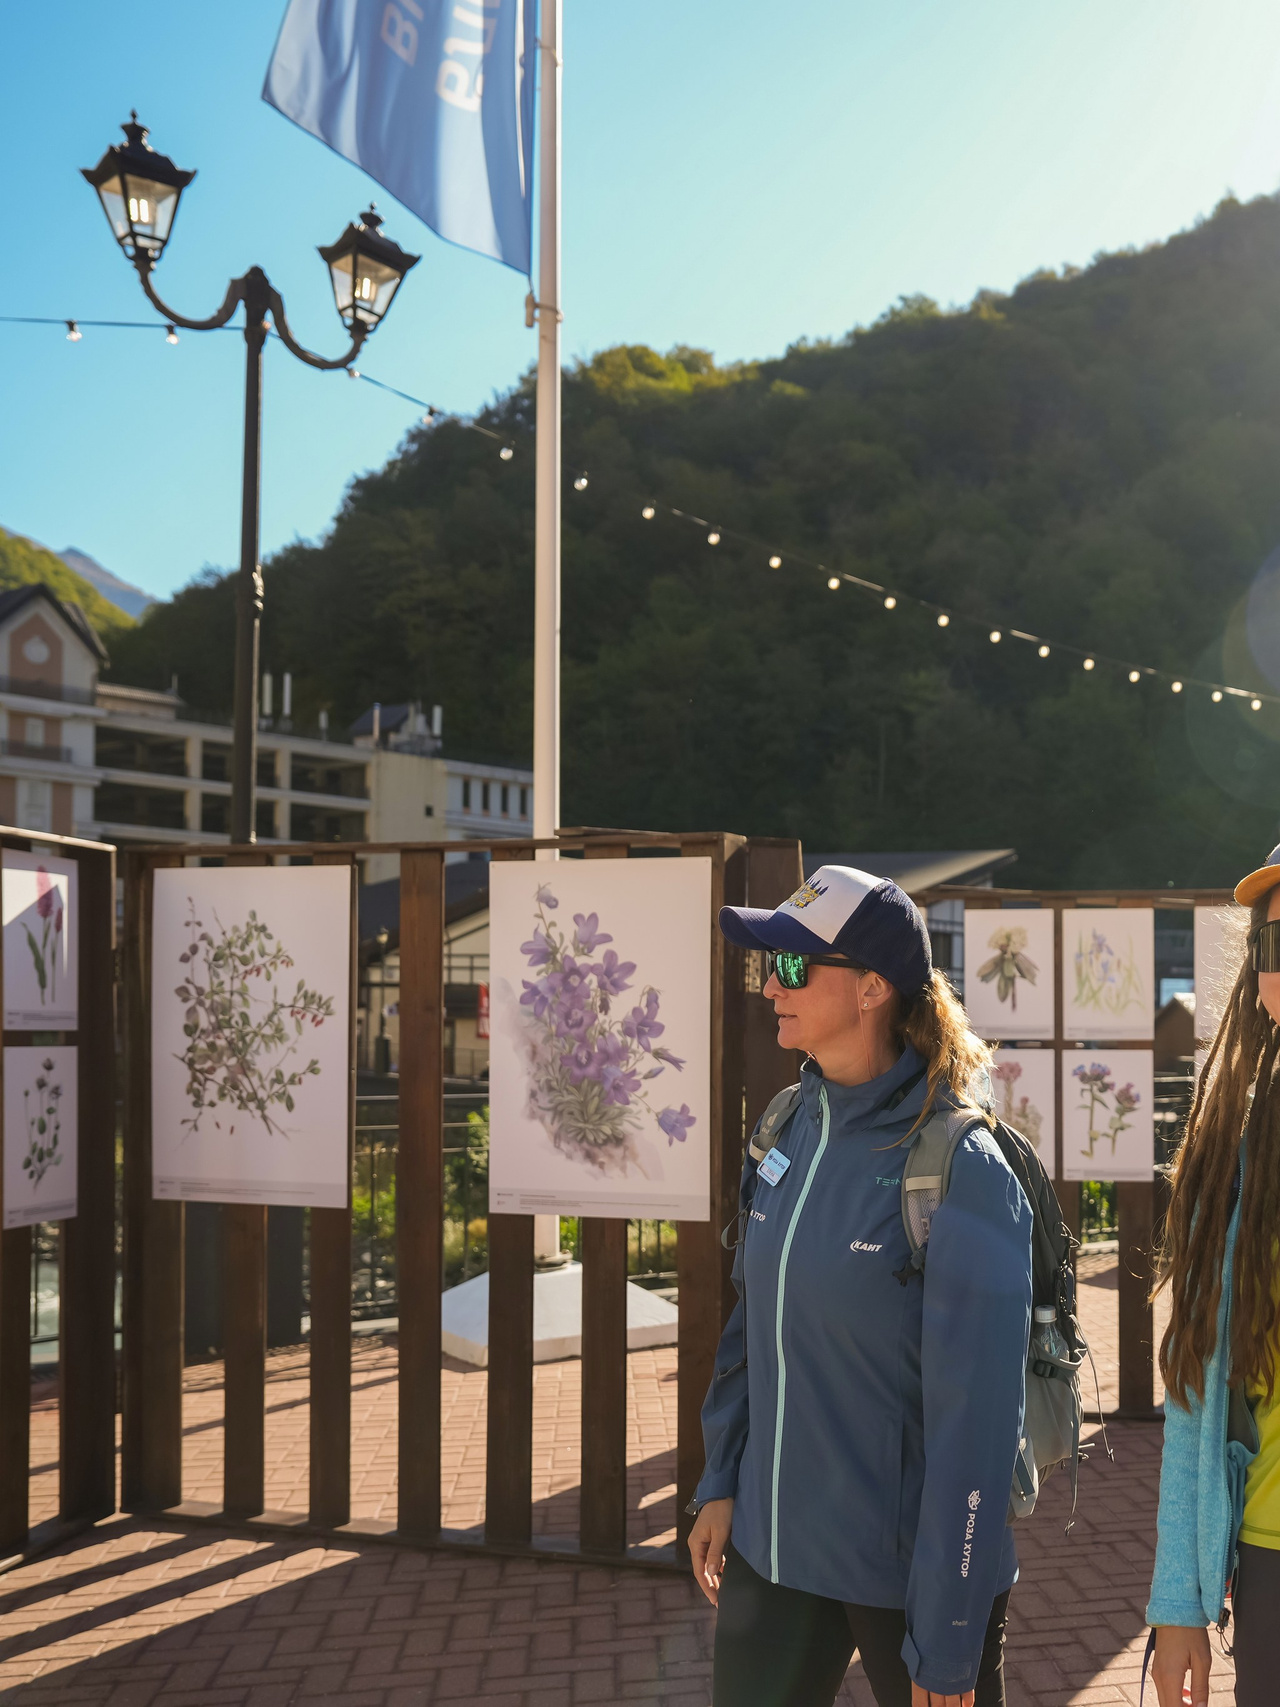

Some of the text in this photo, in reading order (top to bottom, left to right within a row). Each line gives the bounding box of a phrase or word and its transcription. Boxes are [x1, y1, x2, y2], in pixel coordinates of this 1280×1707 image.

[853, 1241, 883, 1252] КАНТ
[960, 1513, 976, 1578] РОЗА ХУТОР
